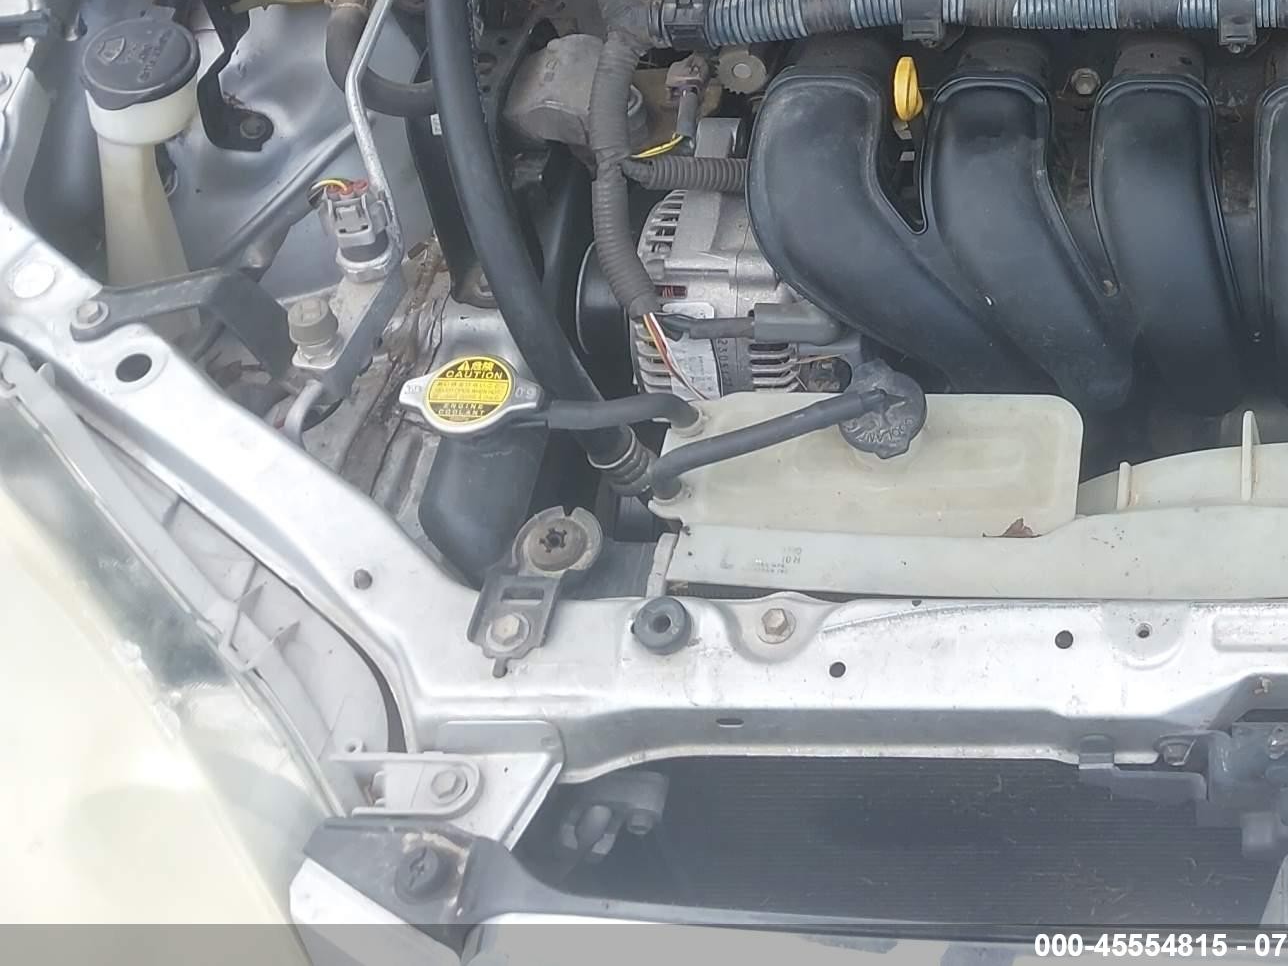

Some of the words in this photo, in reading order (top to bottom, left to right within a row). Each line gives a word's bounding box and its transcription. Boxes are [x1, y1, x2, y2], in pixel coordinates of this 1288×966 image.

[445, 370, 503, 379] CAUTION
[443, 402, 484, 410] ENGINE
[438, 408, 485, 416] COOLANT
